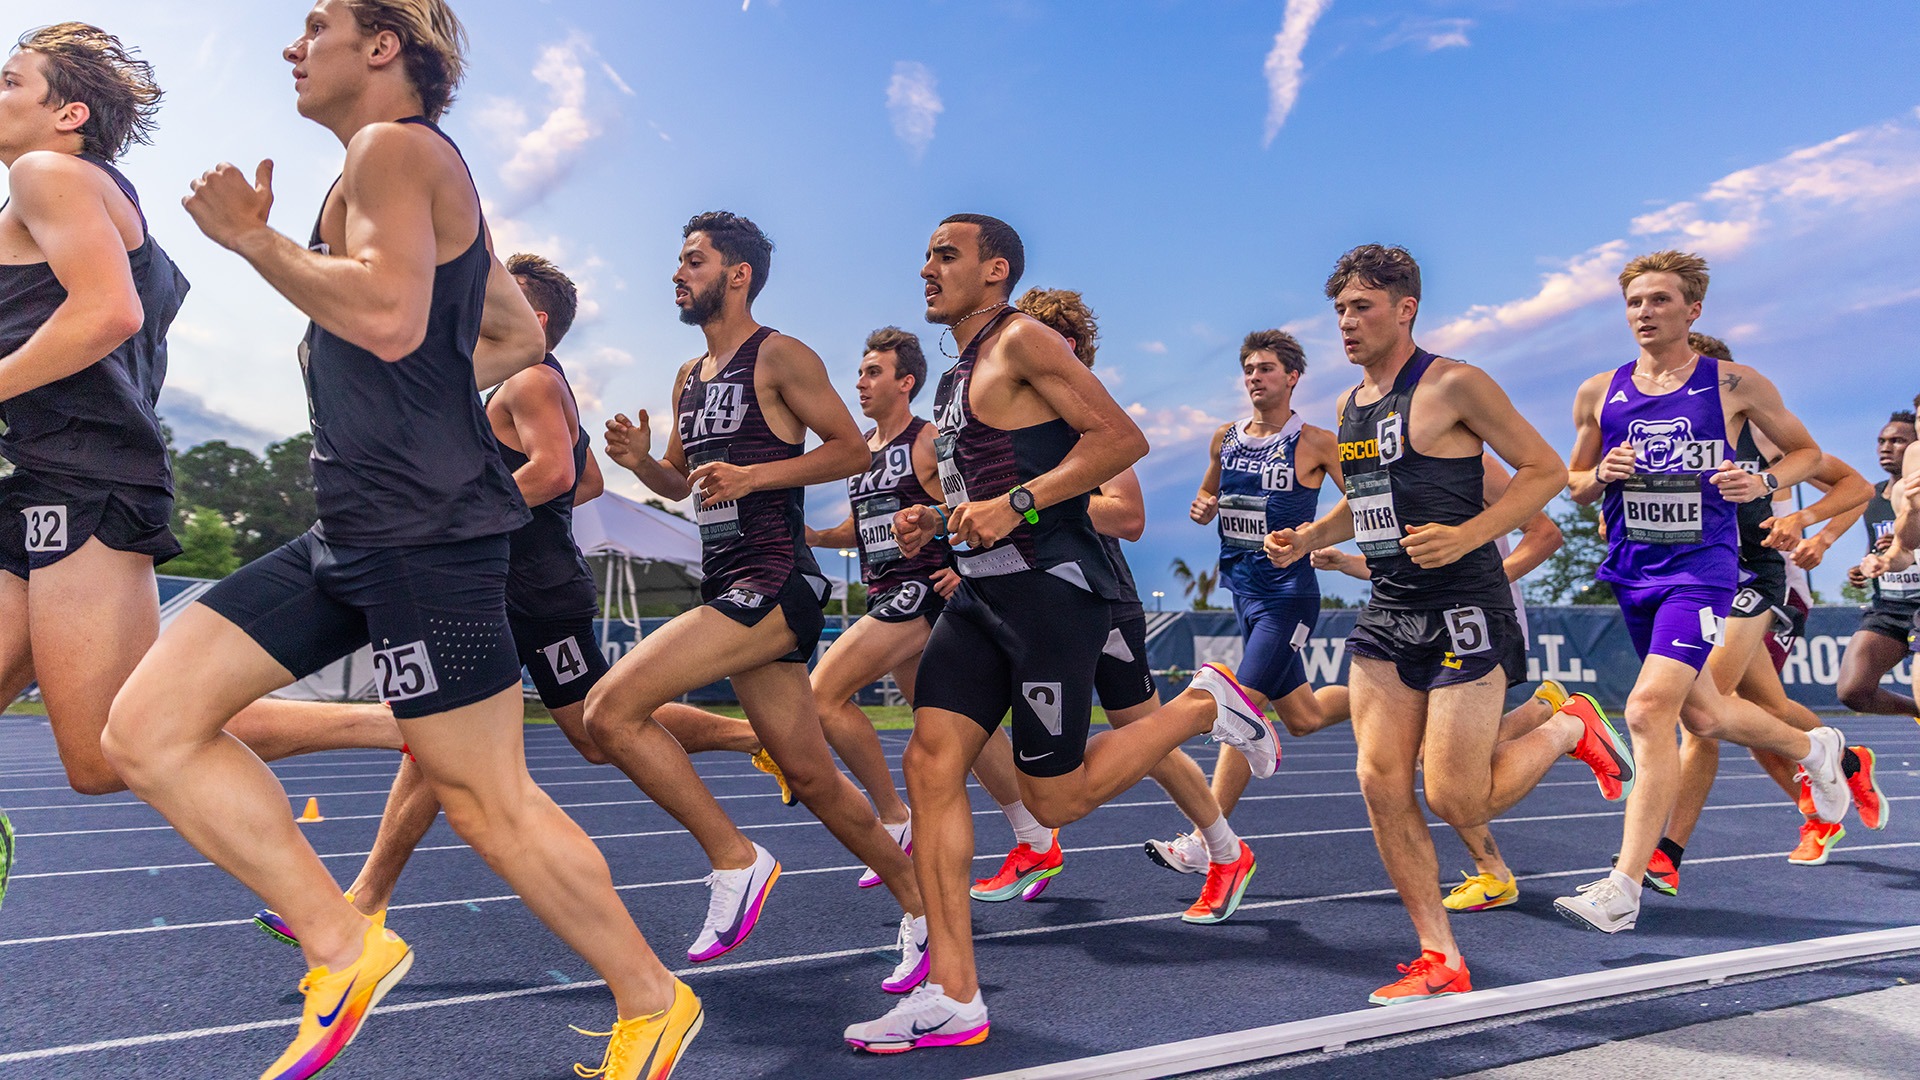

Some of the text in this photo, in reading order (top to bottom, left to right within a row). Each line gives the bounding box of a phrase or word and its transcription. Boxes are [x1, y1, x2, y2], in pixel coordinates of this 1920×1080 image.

[705, 384, 735, 419] 24
[1381, 418, 1397, 460] 5
[889, 448, 907, 476] 9
[1686, 441, 1716, 469] 31
[1266, 468, 1288, 490] 15
[1221, 515, 1266, 535] DEVINE
[1627, 501, 1698, 523] BICKLE
[29, 510, 62, 548] 32
[1735, 589, 1756, 608] 6
[1450, 609, 1482, 651] 5
[373, 646, 426, 699] 25
[556, 641, 581, 677] 4
